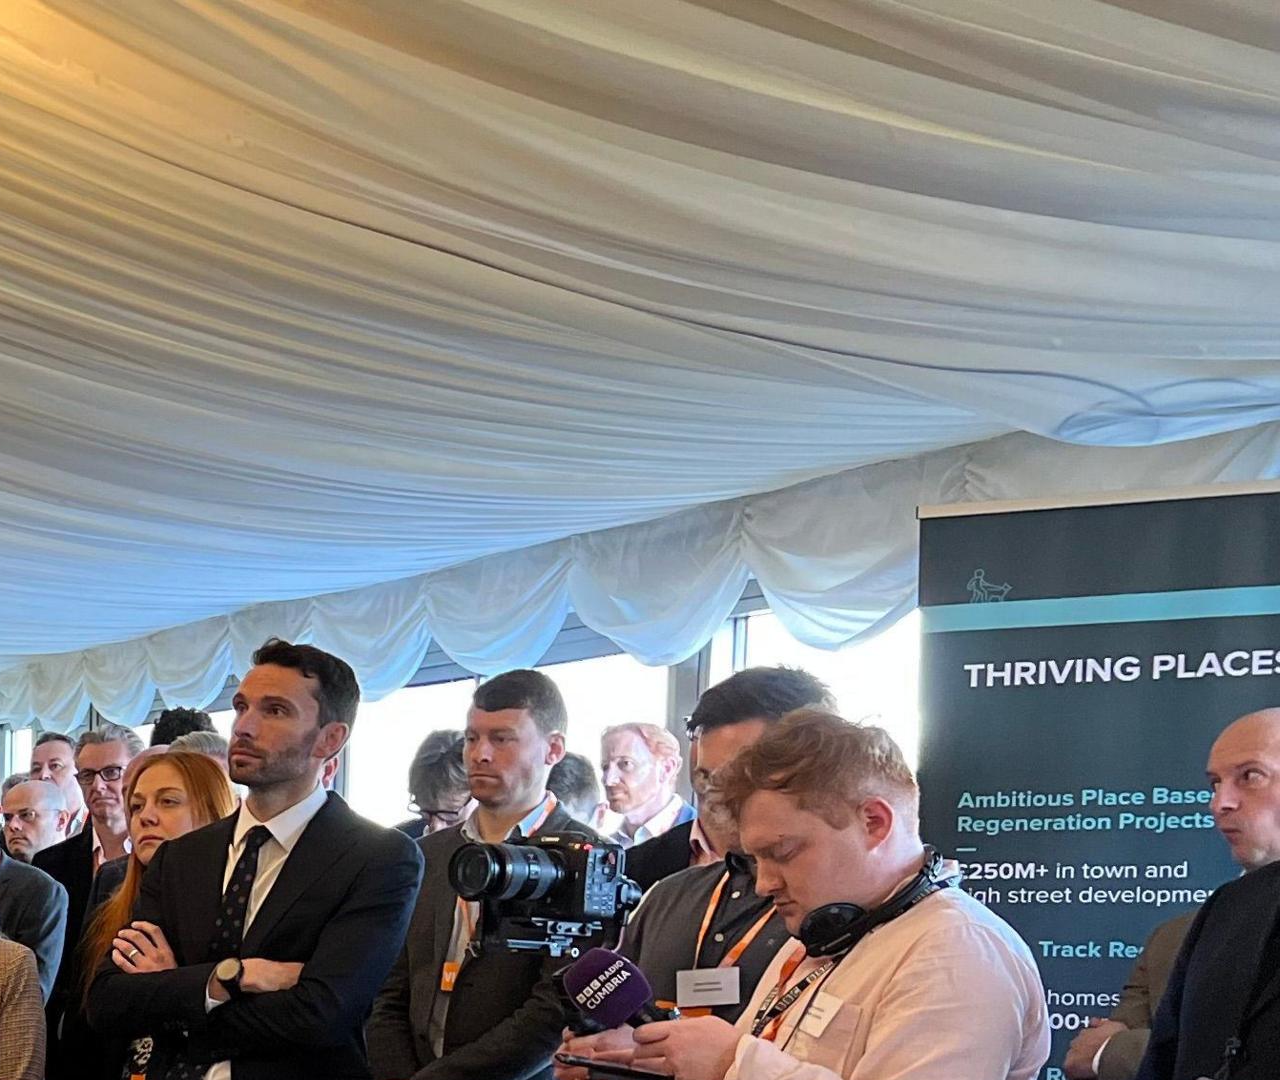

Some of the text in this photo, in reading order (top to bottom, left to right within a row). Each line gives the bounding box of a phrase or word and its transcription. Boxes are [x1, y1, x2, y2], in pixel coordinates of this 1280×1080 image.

[963, 649, 1280, 688] THRIVING PLACE
[957, 788, 1215, 809] Ambitious Place Base
[957, 812, 1215, 836] Regeneration Projects
[959, 861, 1188, 881] £250M+ in town and
[966, 887, 1001, 907] igh
[1007, 888, 1072, 904] street
[1038, 940, 1101, 958] Track
[576, 960, 624, 1004] BBC RADIO
[586, 970, 632, 1010] CUMBRIA
[1047, 990, 1121, 1007] homes
